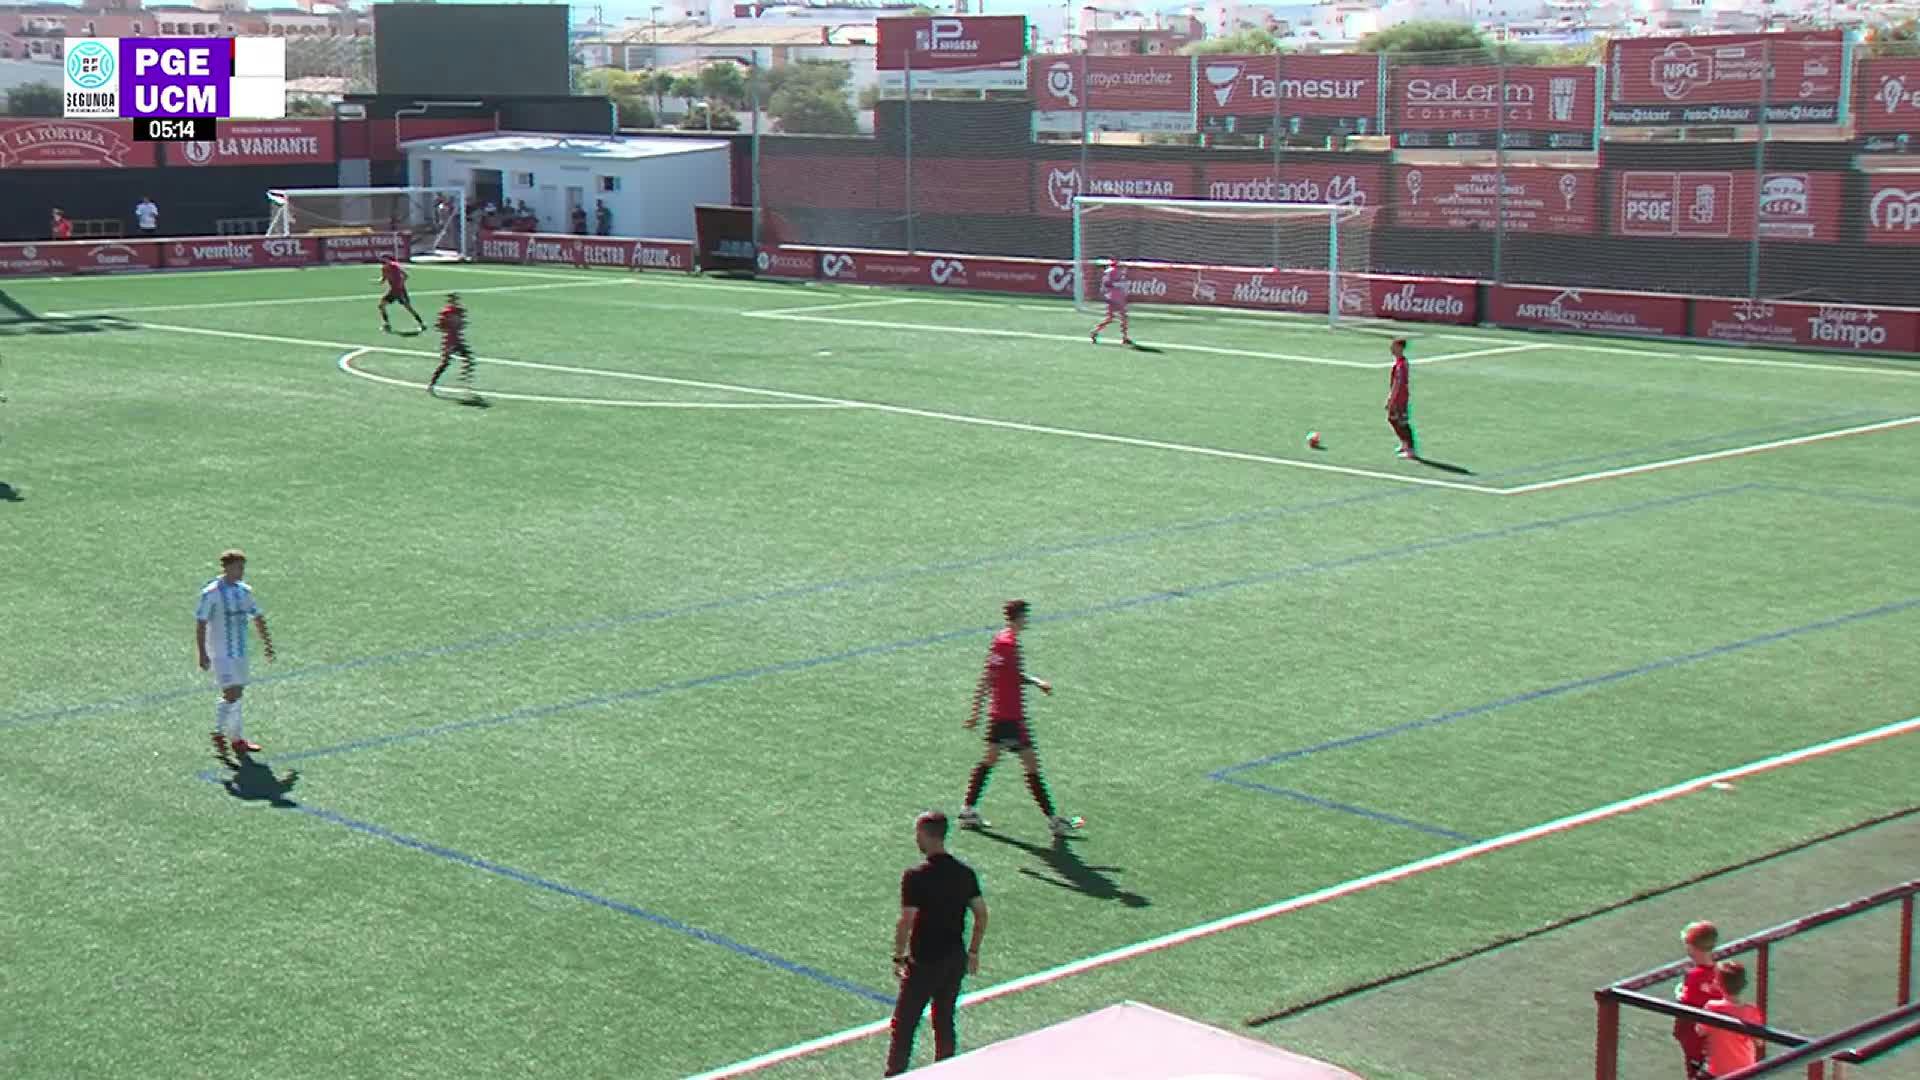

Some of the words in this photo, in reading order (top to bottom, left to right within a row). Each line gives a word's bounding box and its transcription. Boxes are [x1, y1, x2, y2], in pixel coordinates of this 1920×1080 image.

[1662, 62, 1699, 79] NPG
[1247, 75, 1364, 99] Tamesur
[1407, 78, 1534, 101] Salerm
[15, 131, 36, 145] LA
[217, 137, 239, 155] LA
[240, 136, 318, 155] VARIANTE
[1626, 200, 1673, 221] PSOE
[1232, 282, 1308, 305] Mozuelo
[1382, 290, 1464, 316] Mozuelo
[1808, 317, 1886, 348] Tempo
